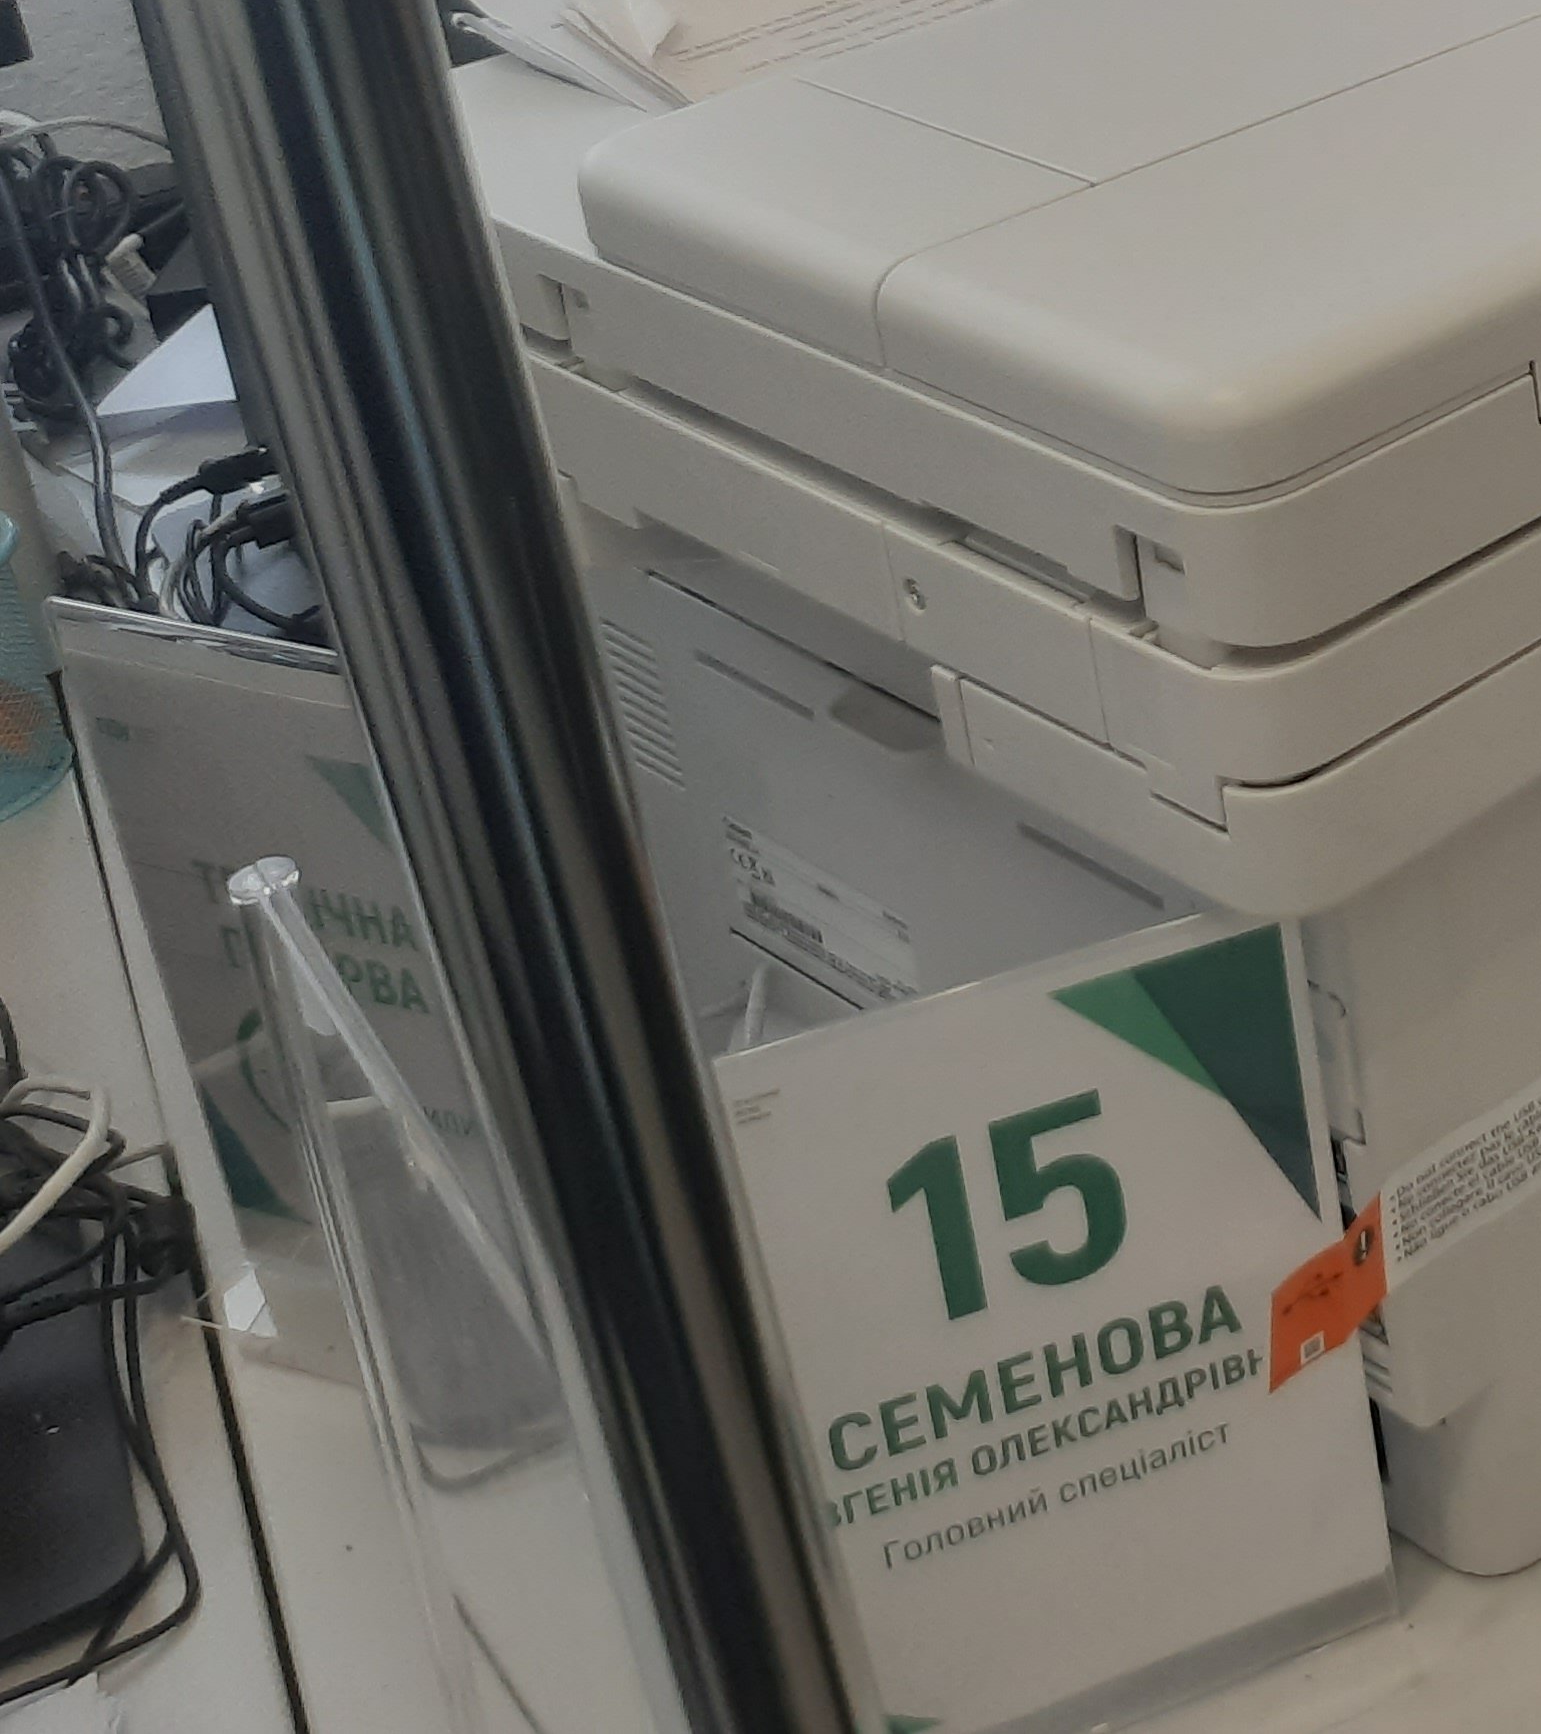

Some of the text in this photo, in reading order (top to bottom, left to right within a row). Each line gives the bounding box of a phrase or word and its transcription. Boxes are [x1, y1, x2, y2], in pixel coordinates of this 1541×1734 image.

[886, 1087, 1128, 1321] 15
[828, 1284, 1243, 1472] СЕМЕНОВА
[829, 1347, 1265, 1528] ВГЕНІЯ ОЛЕКСАНДРІВН
[882, 1422, 1230, 1569] Головний спеціаліст
